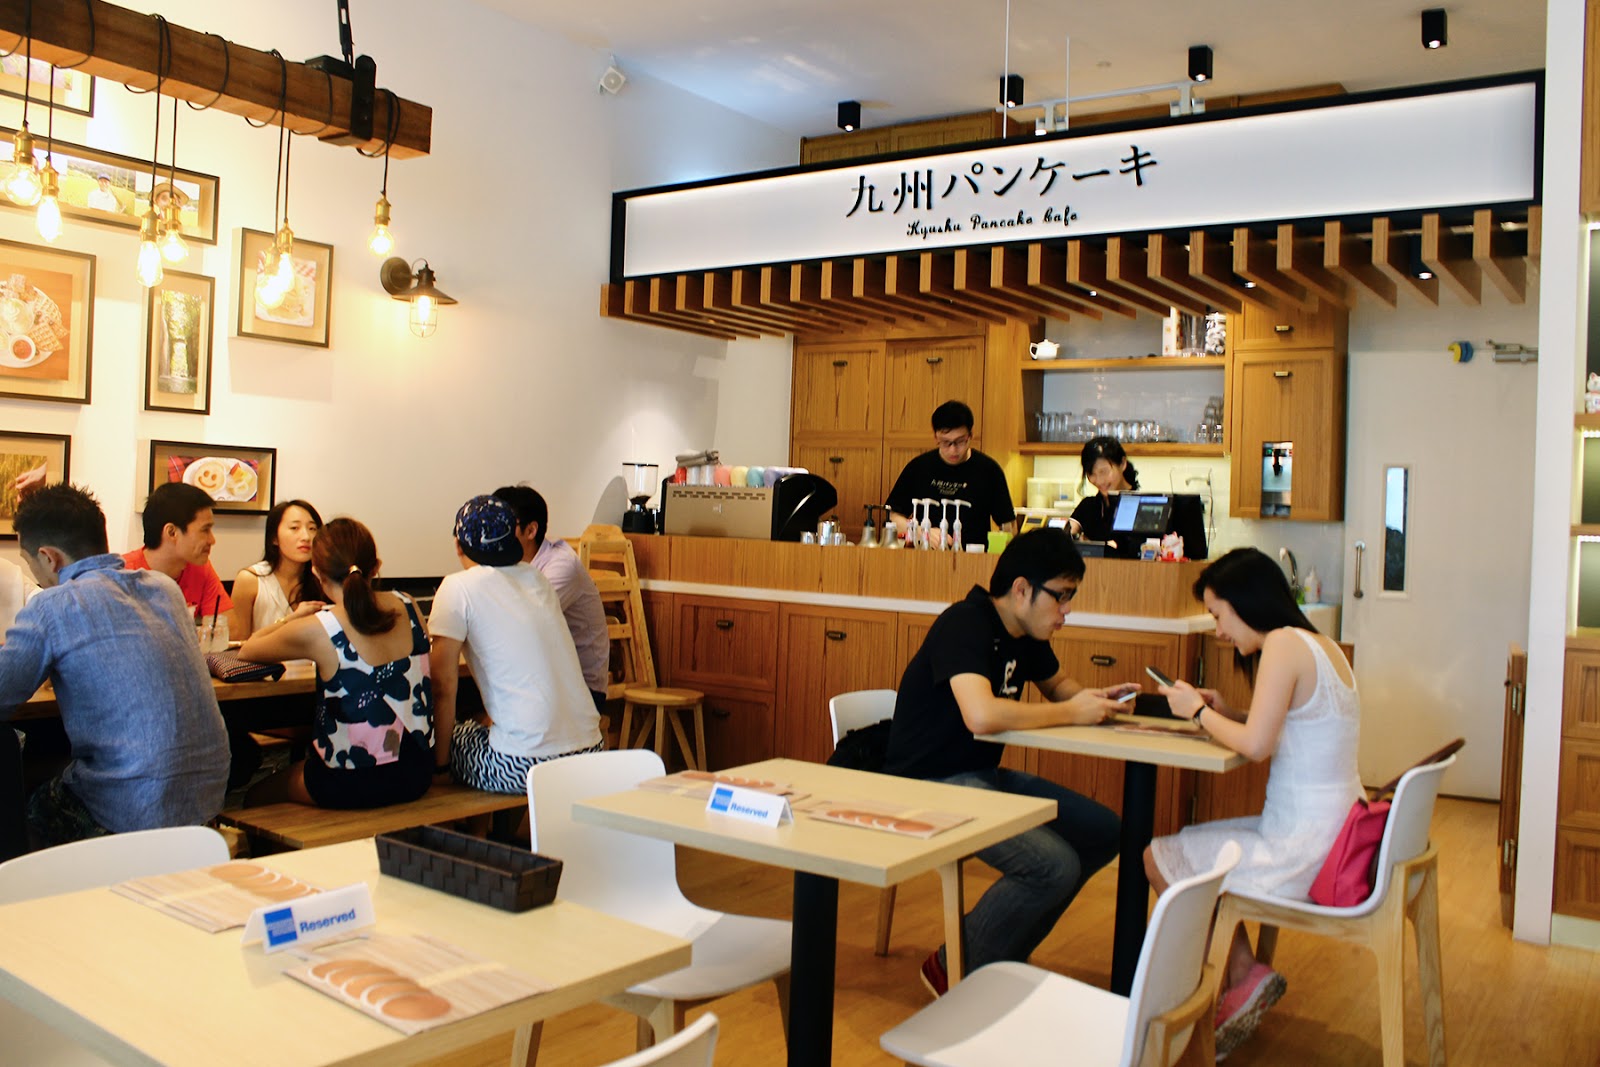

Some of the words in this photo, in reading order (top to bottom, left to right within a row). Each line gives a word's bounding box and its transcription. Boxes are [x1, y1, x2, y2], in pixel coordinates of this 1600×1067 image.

[846, 145, 1157, 218] 九州パンケーキ
[907, 217, 961, 240] Kyushu
[970, 209, 1033, 230] Pancake
[731, 803, 768, 818] Reserved
[300, 908, 356, 933] Reserved
